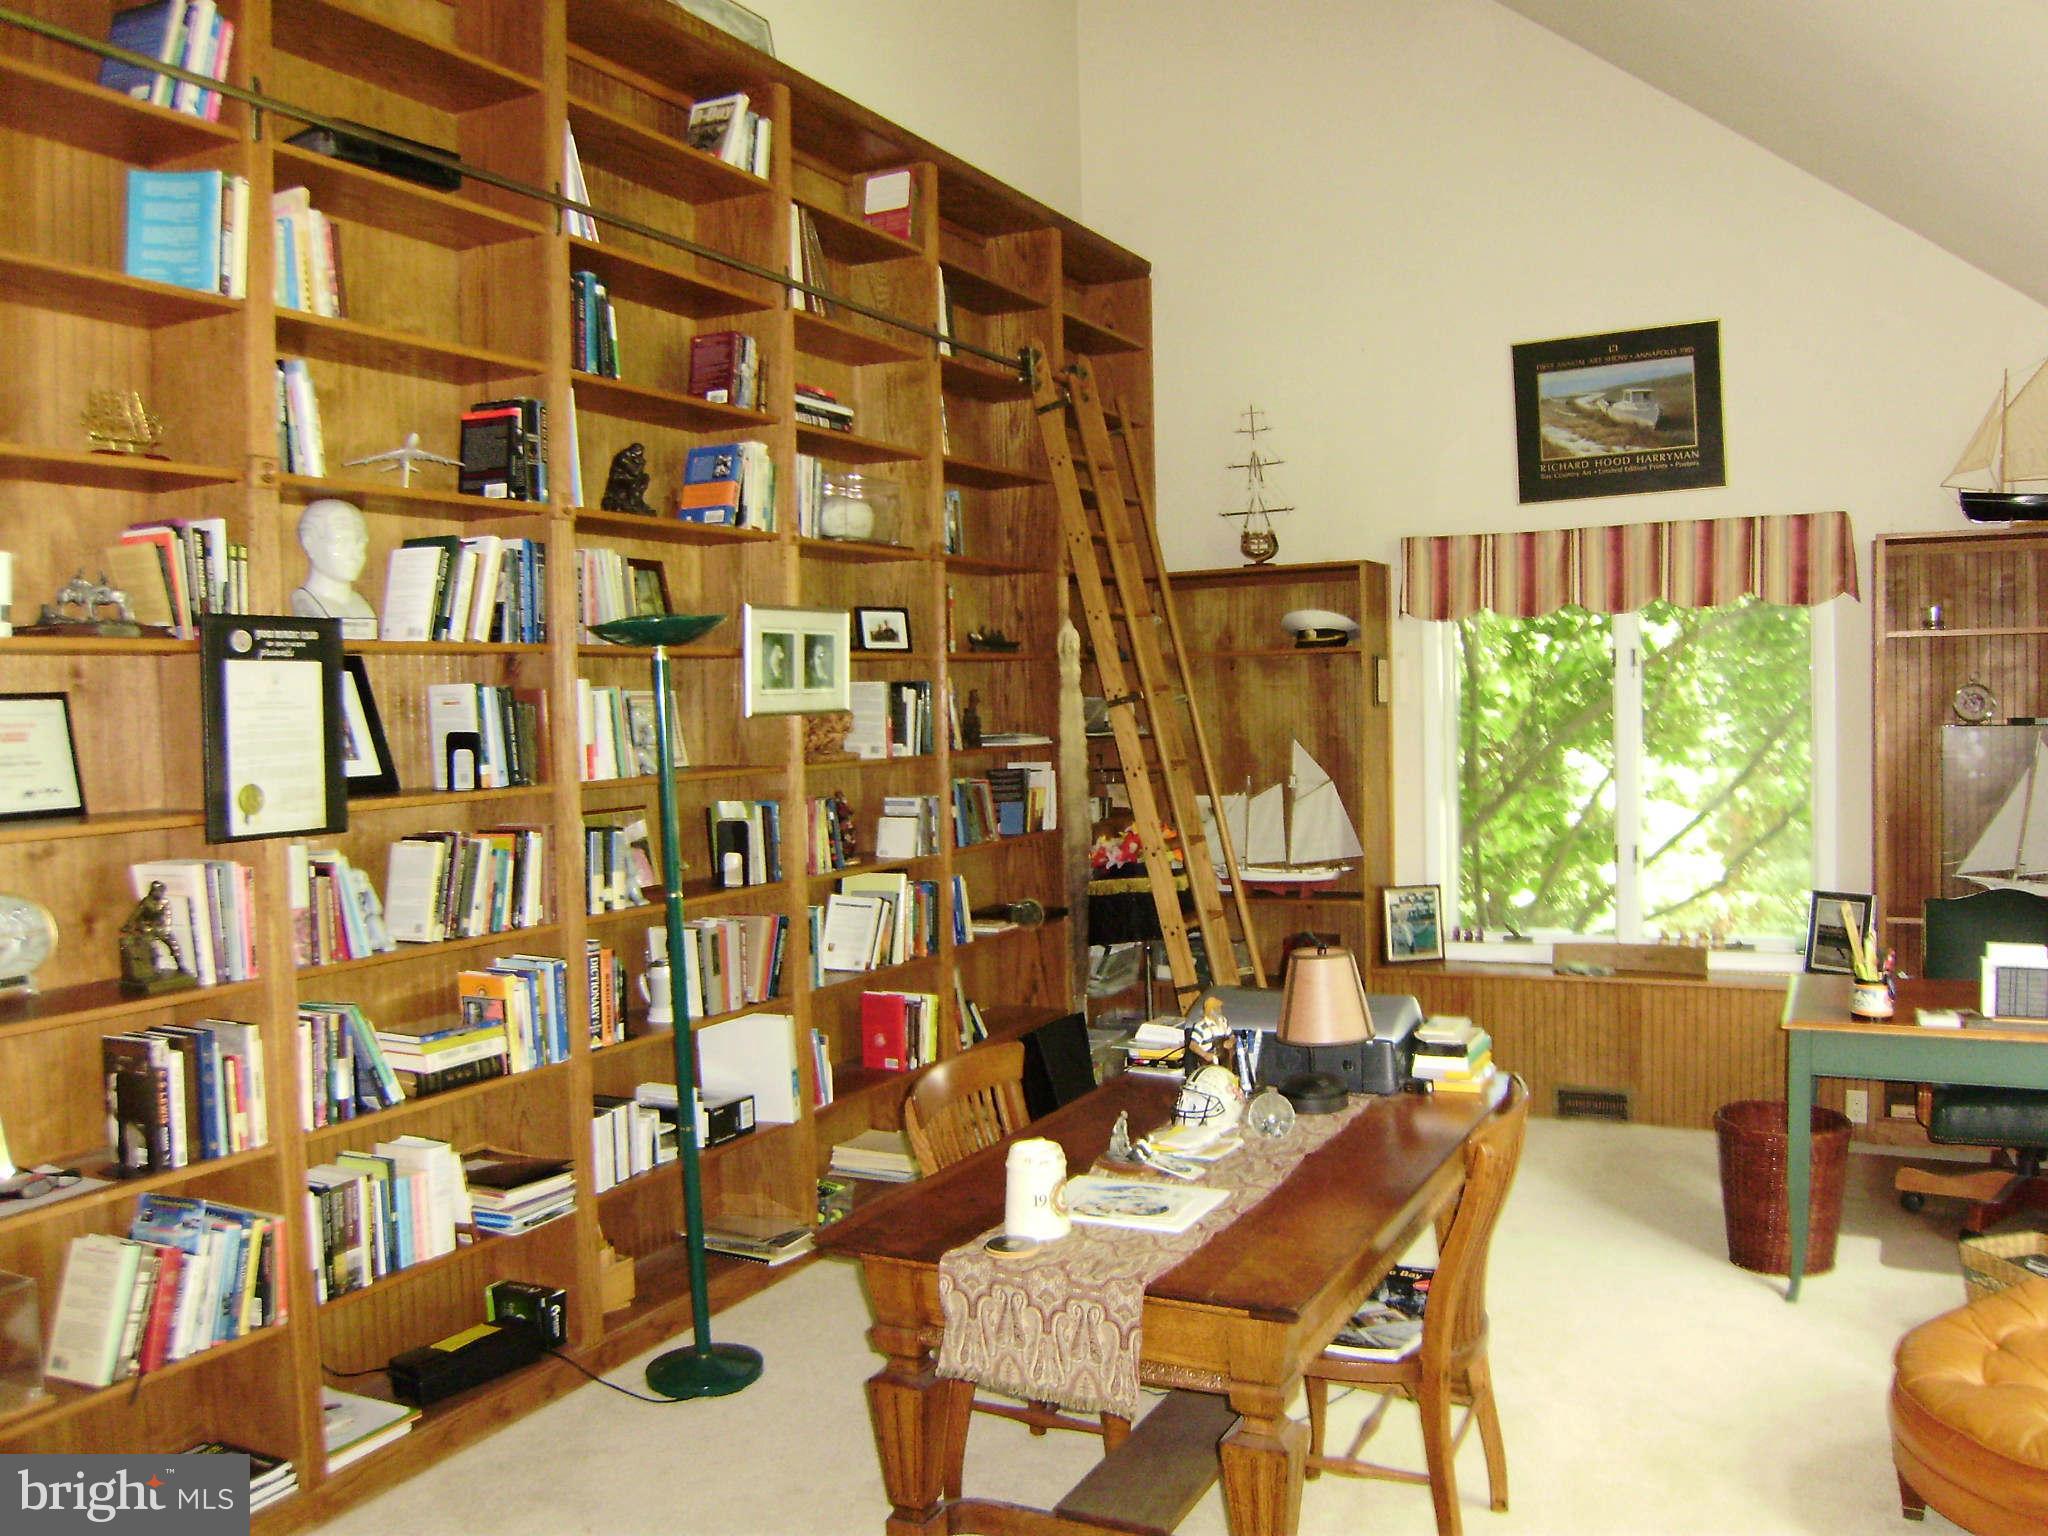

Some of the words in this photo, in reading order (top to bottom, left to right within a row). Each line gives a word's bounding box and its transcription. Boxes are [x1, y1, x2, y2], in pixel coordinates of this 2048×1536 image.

[1540, 460, 1589, 472] RICHARD
[1595, 456, 1631, 468] HOOD
[1636, 450, 1700, 464] HARRYMAN
[590, 957, 600, 1019] DICTIONARY
[158, 1091, 169, 1125] LEWIS
[1400, 1270, 1423, 1280] Bay
